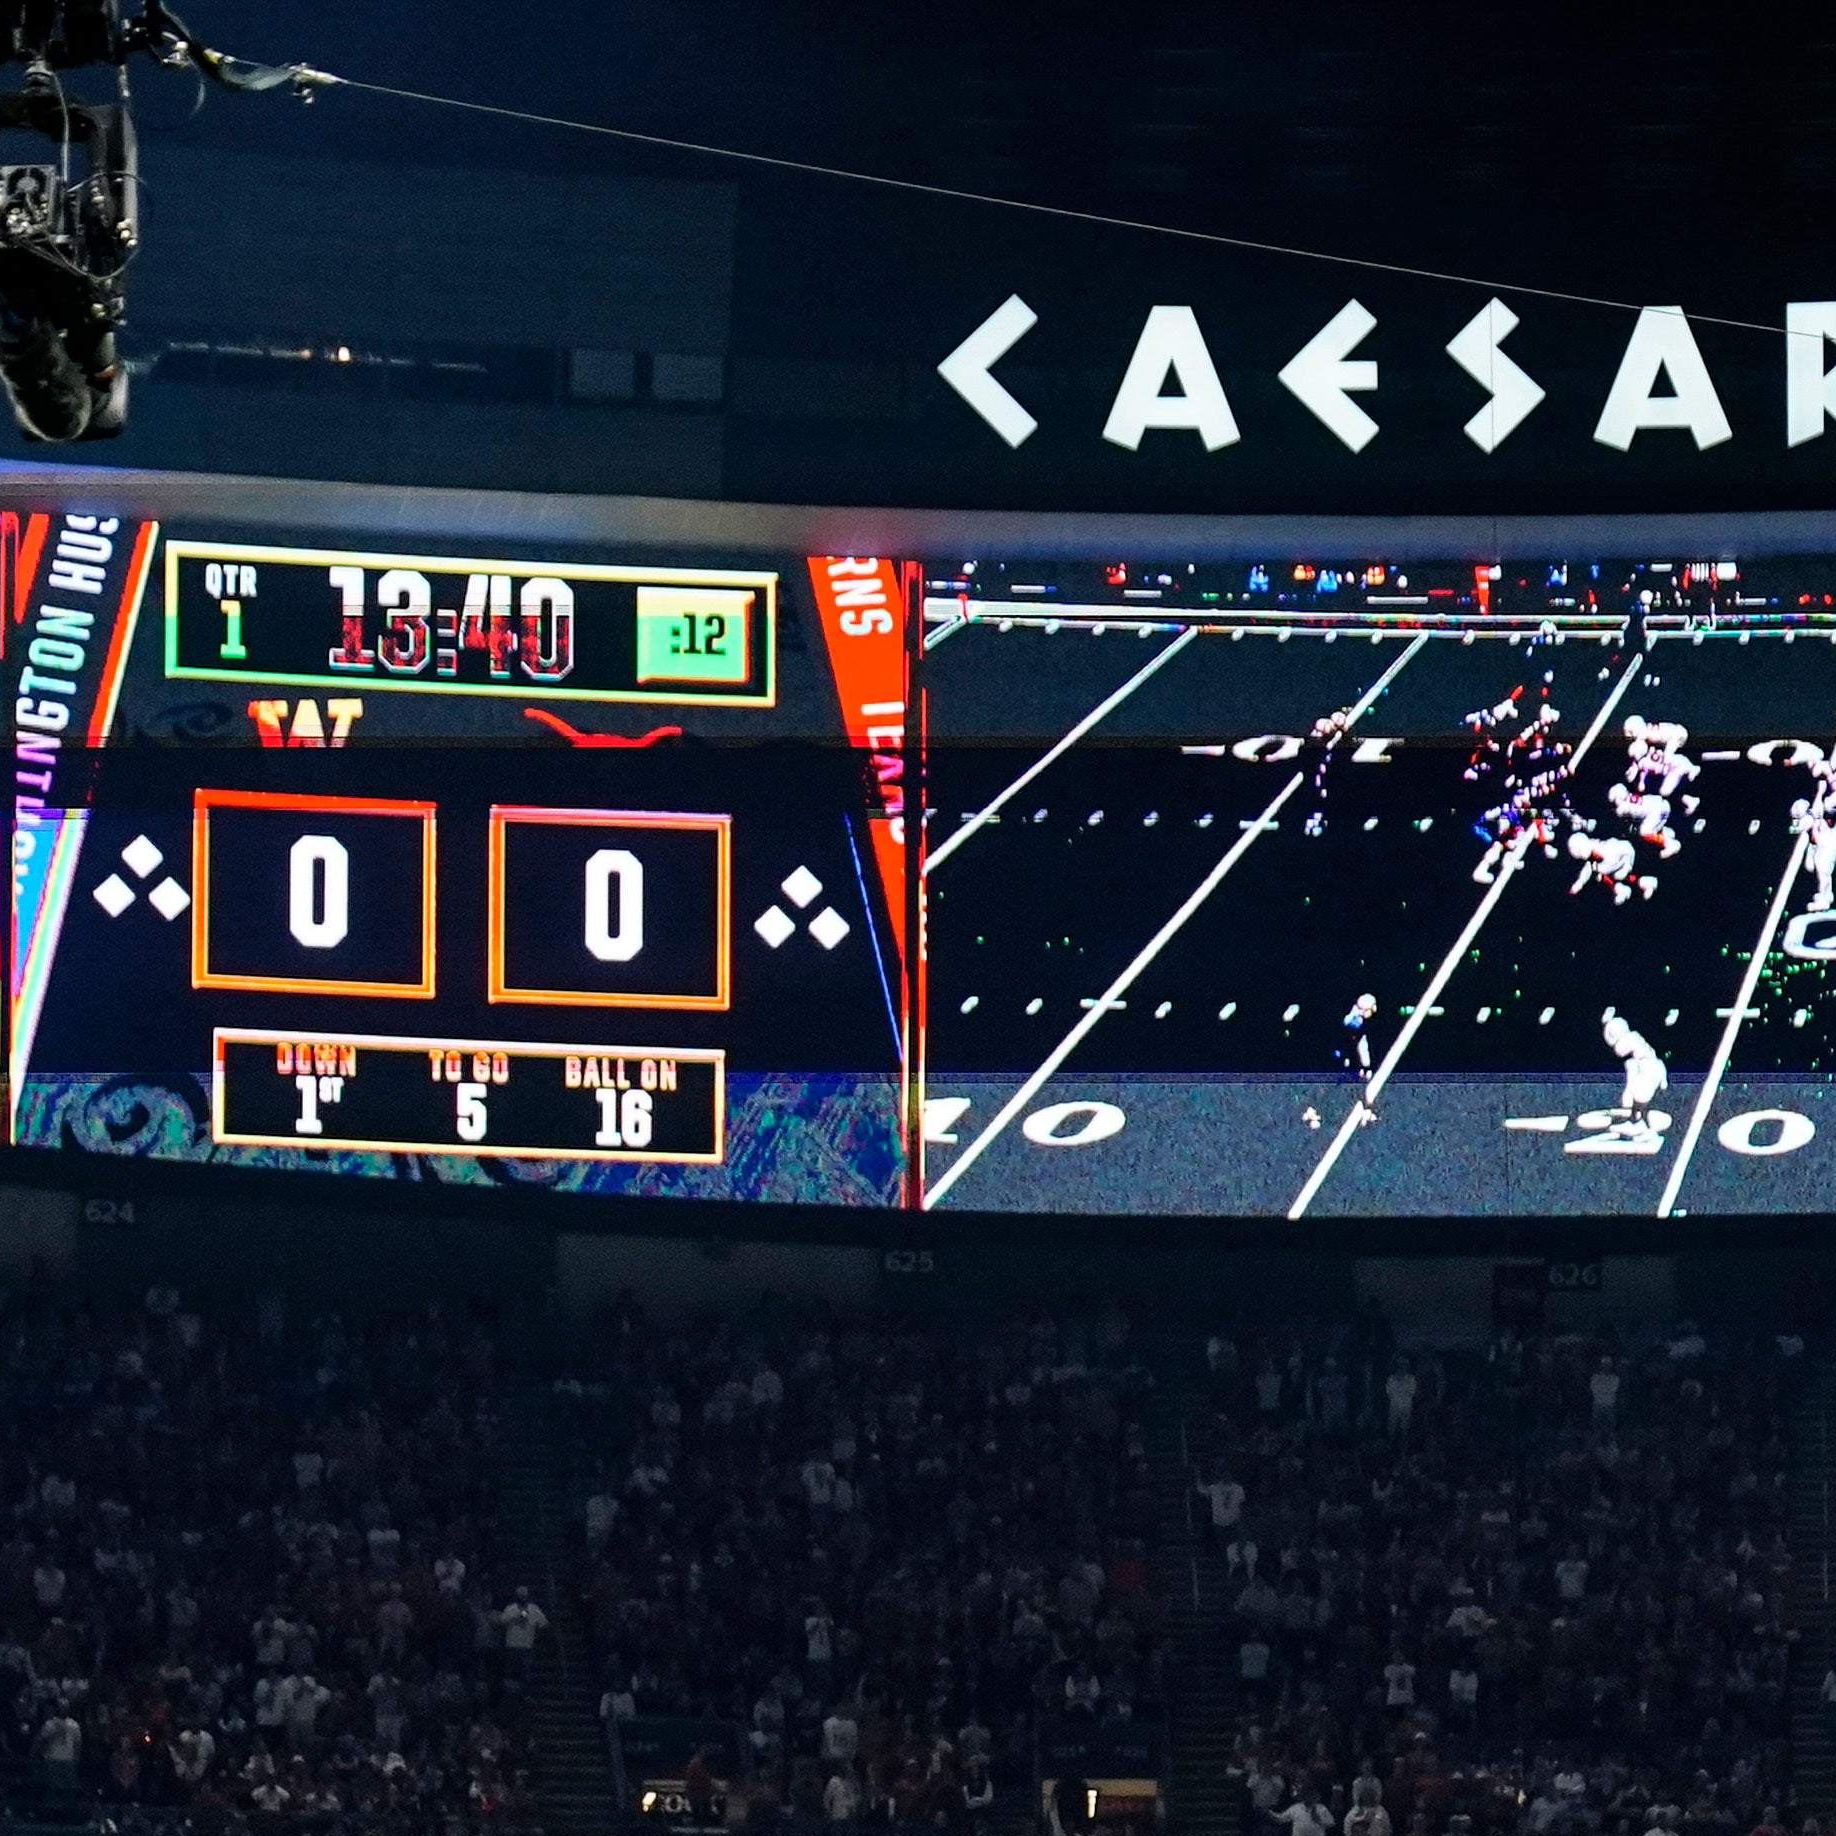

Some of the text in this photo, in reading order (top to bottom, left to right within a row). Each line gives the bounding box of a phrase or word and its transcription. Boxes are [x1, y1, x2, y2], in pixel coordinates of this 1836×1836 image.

[205, 562, 257, 597] QTR
[220, 600, 247, 658] 1
[329, 564, 575, 682] 13:40
[668, 611, 727, 656] :12
[289, 834, 349, 949] 0
[584, 849, 644, 962] 0
[275, 1041, 357, 1077] DOWN
[427, 1050, 509, 1083] TO GO
[564, 1056, 678, 1090] BALL ON
[455, 1085, 487, 1141] 5
[595, 1088, 652, 1147] 16
[84, 1198, 135, 1225] 624
[884, 1251, 934, 1273] 625
[1548, 1262, 1598, 1287] 626
